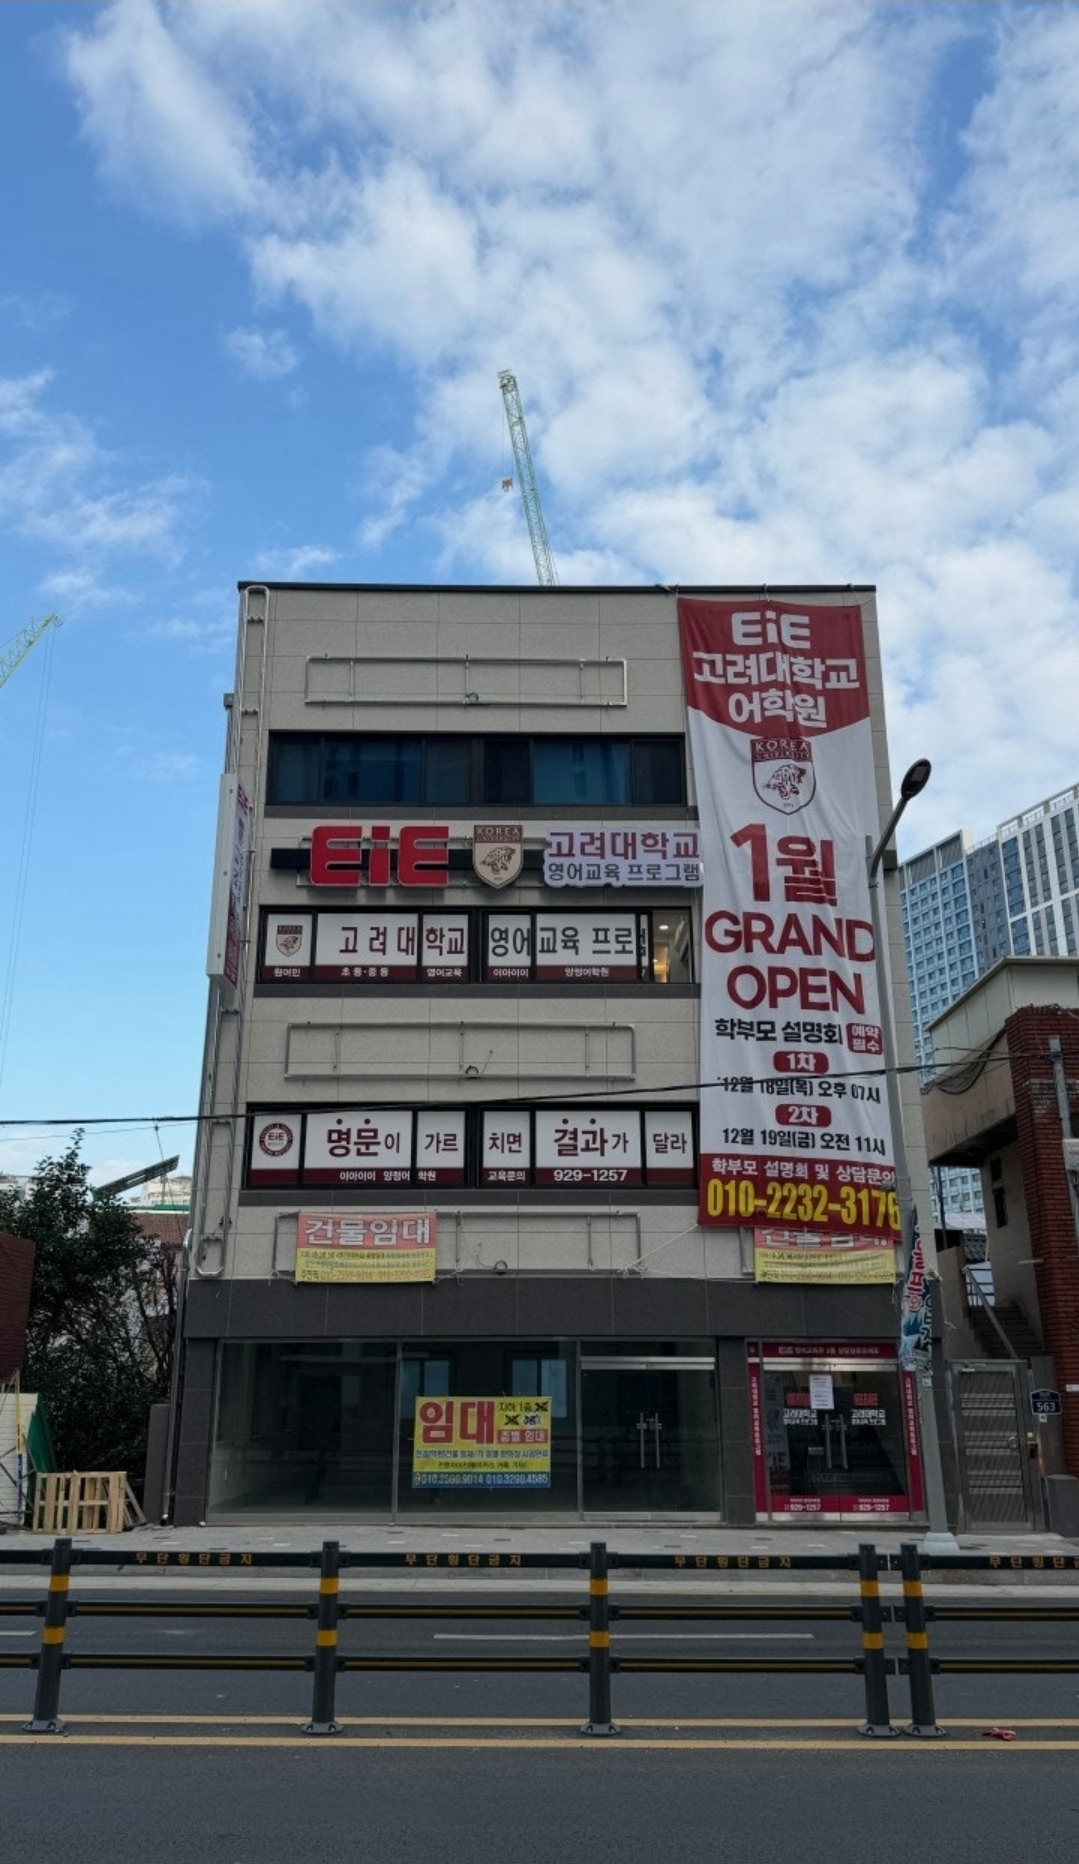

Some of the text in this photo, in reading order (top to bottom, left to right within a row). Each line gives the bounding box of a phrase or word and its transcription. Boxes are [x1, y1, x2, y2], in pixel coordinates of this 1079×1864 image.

[731, 611, 811, 648] EiE
[693, 651, 860, 690] 고려대학교
[728, 688, 827, 728] 어학원
[756, 739, 808, 752] KOREA
[476, 827, 520, 836] KOREA
[309, 825, 450, 887] EiE
[549, 832, 700, 860] 고려대학교
[549, 863, 700, 882] 영어교육 프로그램
[730, 823, 838, 906] 1월
[339, 927, 465, 956] 고려대학교
[704, 910, 876, 962] GRAND
[727, 965, 865, 1015] OPEN
[715, 1018, 843, 1045] 학부모 설명회
[851, 1024, 880, 1038] 예약
[851, 1038, 880, 1053] 필수
[785, 1053, 816, 1072] 1차
[721, 1077, 881, 1104] 12월 18일(목) 오후 07시
[788, 1105, 818, 1125] 2차
[327, 1127, 401, 1157] 명문이
[554, 1127, 629, 1157] 결과가
[653, 1132, 688, 1154] 달라
[722, 1128, 886, 1156] 12월 19일(금) 오전 11시
[339, 1170, 376, 1181] 이아이이
[487, 1171, 526, 1182] 교육문의
[553, 1169, 628, 1182] 929-1257
[711, 1158, 758, 1176] 학부모
[764, 1161, 809, 1180] 설명회
[814, 1164, 830, 1181] 및
[707, 1178, 902, 1231] 010-2232-3176
[305, 1218, 430, 1246] 건물임대
[1036, 1402, 1055, 1412] 563
[419, 1400, 495, 1444] 임대
